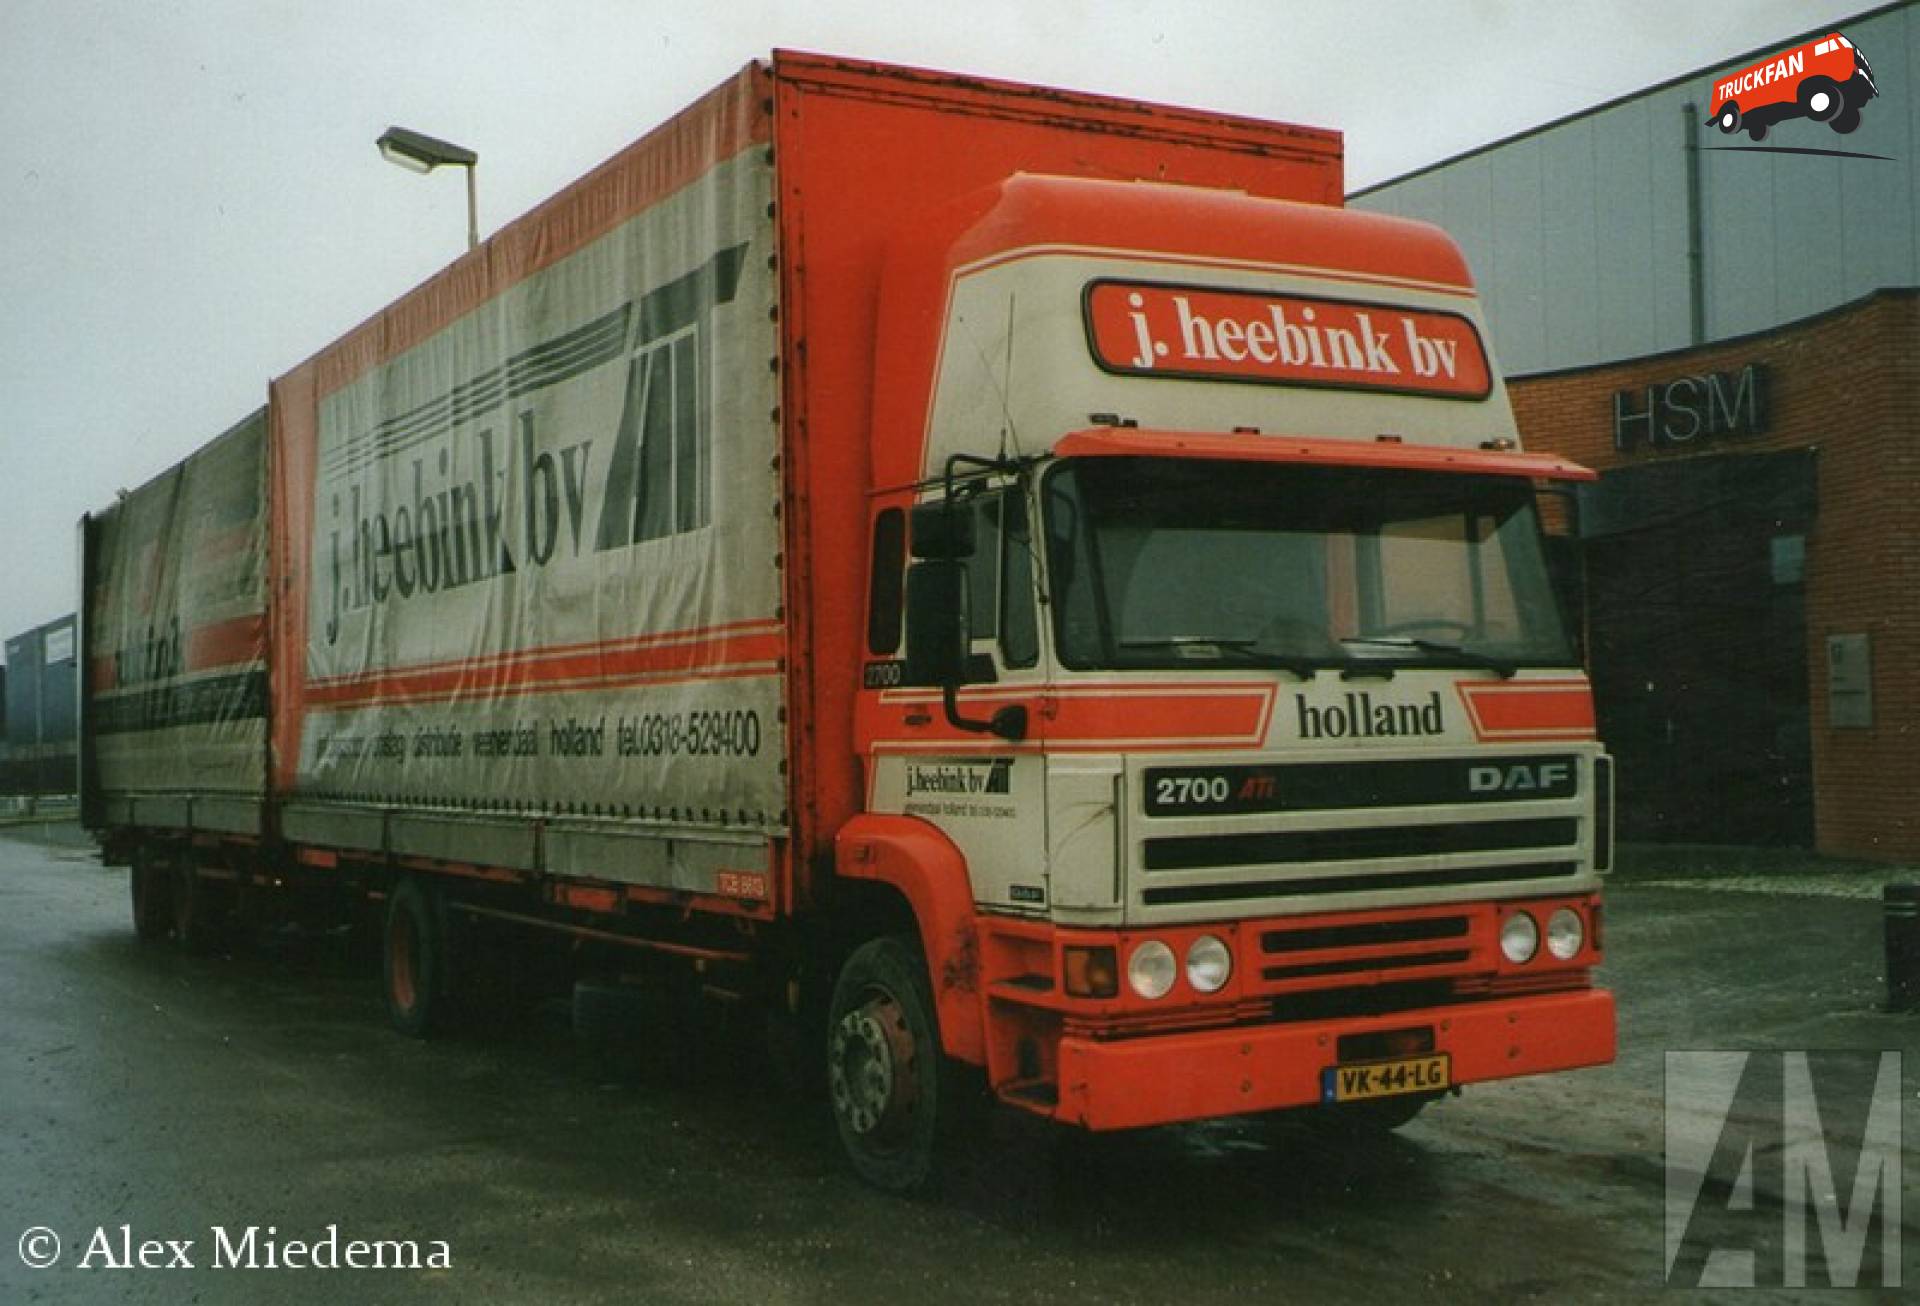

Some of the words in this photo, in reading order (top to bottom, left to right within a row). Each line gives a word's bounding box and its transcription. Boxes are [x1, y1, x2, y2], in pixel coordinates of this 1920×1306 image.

[1173, 297, 1401, 374] heebink
[1403, 318, 1457, 378] bv
[1614, 364, 1757, 449] HSM
[519, 409, 593, 567] bv
[550, 714, 606, 757] holland
[1296, 691, 1445, 739] holland
[1156, 776, 1229, 804] 2700
[1469, 763, 1568, 792] DAF
[1343, 1060, 1441, 1093] VK-44-LG
